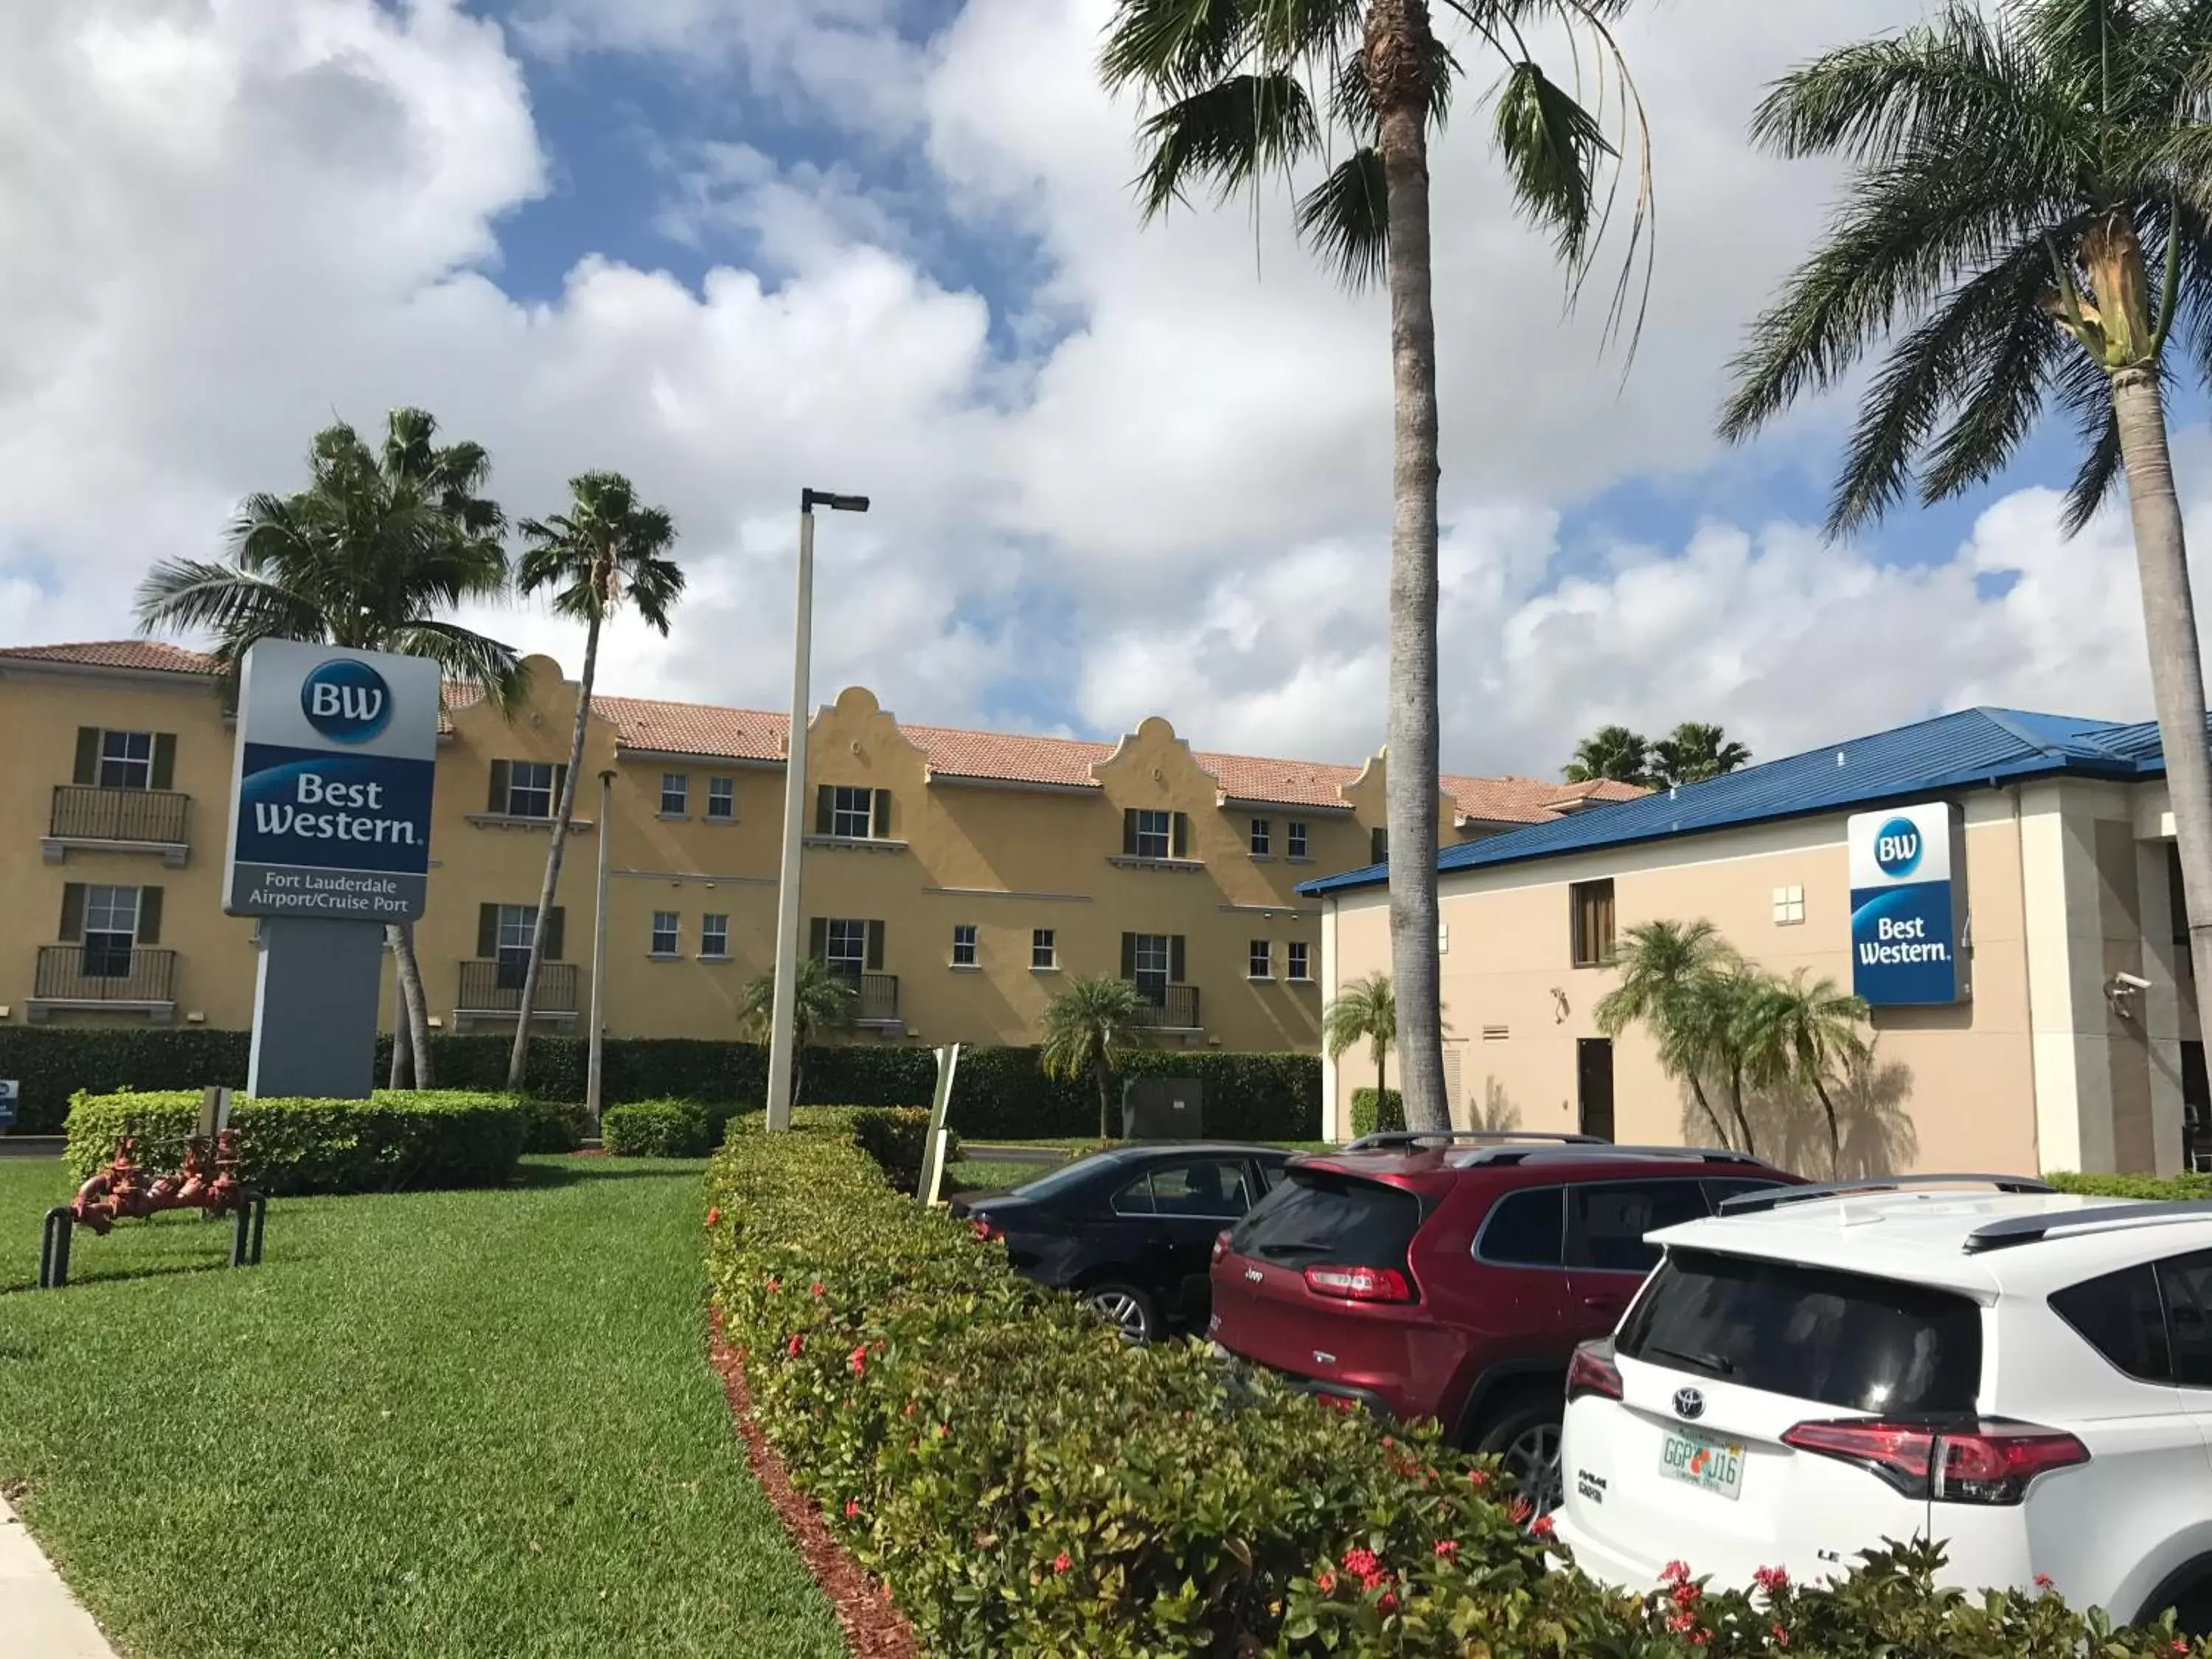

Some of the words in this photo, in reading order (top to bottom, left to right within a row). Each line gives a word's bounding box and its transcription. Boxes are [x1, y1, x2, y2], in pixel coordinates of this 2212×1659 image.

[312, 683, 382, 720] BW
[297, 773, 383, 810] Best
[1879, 833, 1916, 861] BW
[265, 872, 299, 887] Fort
[306, 875, 396, 894] Lauderdale
[249, 889, 369, 910] Airport/Cruise
[374, 897, 408, 912] Port
[1878, 917, 1925, 940] Best
